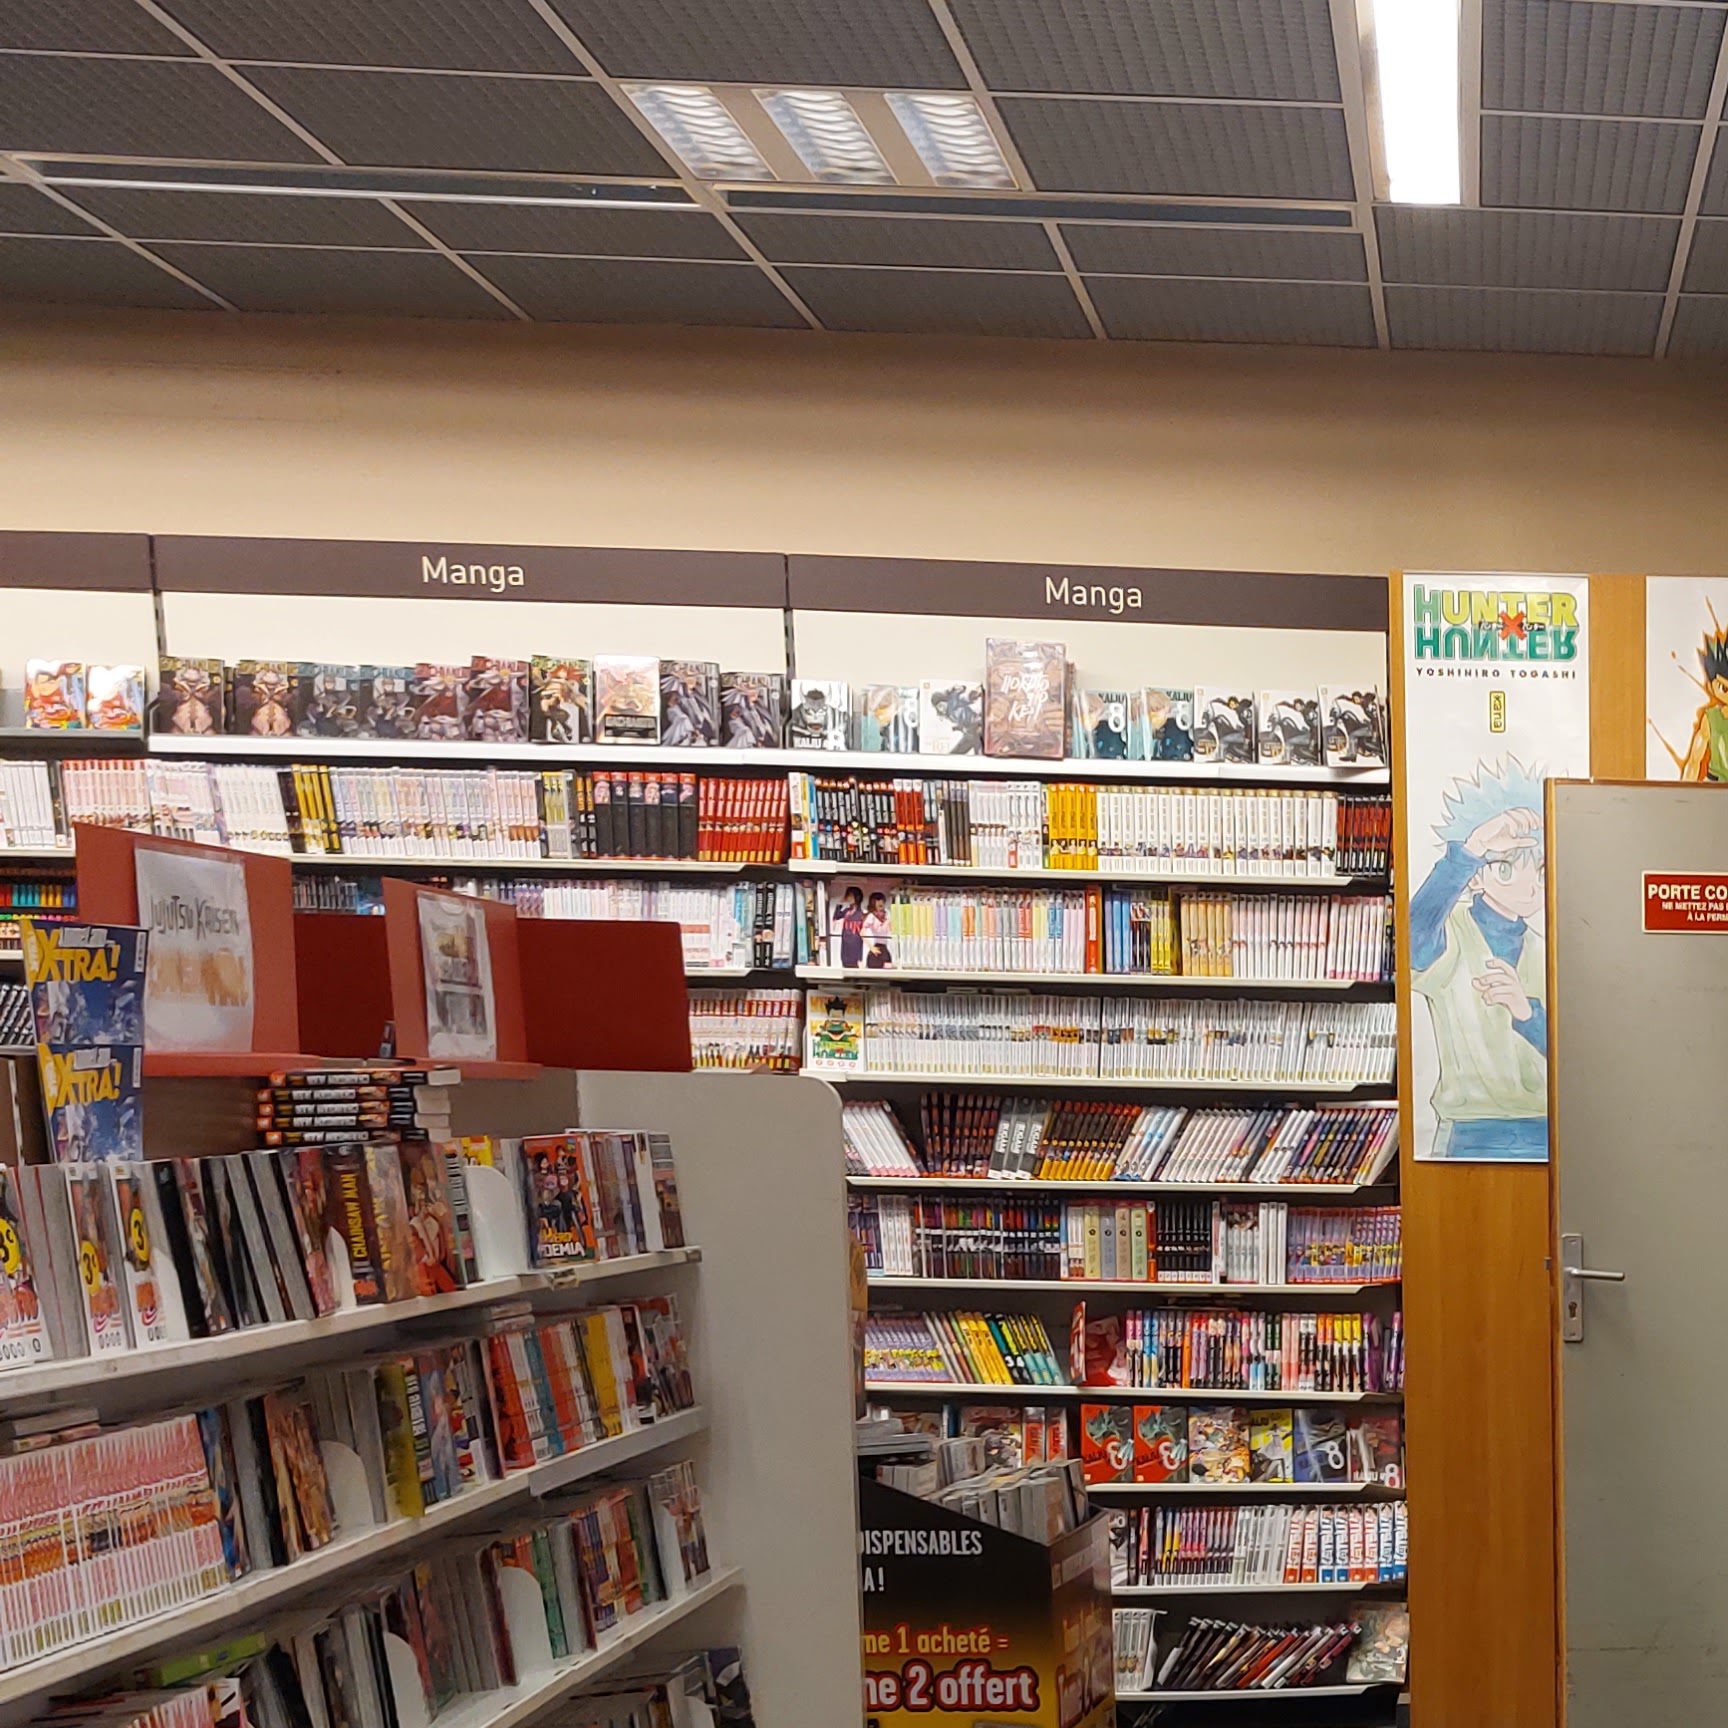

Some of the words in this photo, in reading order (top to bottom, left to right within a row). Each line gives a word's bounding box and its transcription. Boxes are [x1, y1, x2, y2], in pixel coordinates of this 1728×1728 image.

[421, 555, 525, 592] Manga
[1044, 576, 1144, 614] Manga
[1413, 584, 1579, 627] HUNTER
[1416, 667, 1500, 678] YOSHIHIRO
[1510, 670, 1576, 679] TOGASHI
[1108, 702, 1125, 732] 8
[1648, 884, 1701, 900] PORTE
[1708, 902, 1724, 911] PAS
[345, 1201, 368, 1259] CHAINSAW
[1325, 1442, 1345, 1469] 8
[862, 1530, 983, 1555] ISPENSABLES
[917, 1627, 991, 1653] acheté
[909, 1665, 928, 1705] 2
[940, 1665, 1033, 1705] offert
